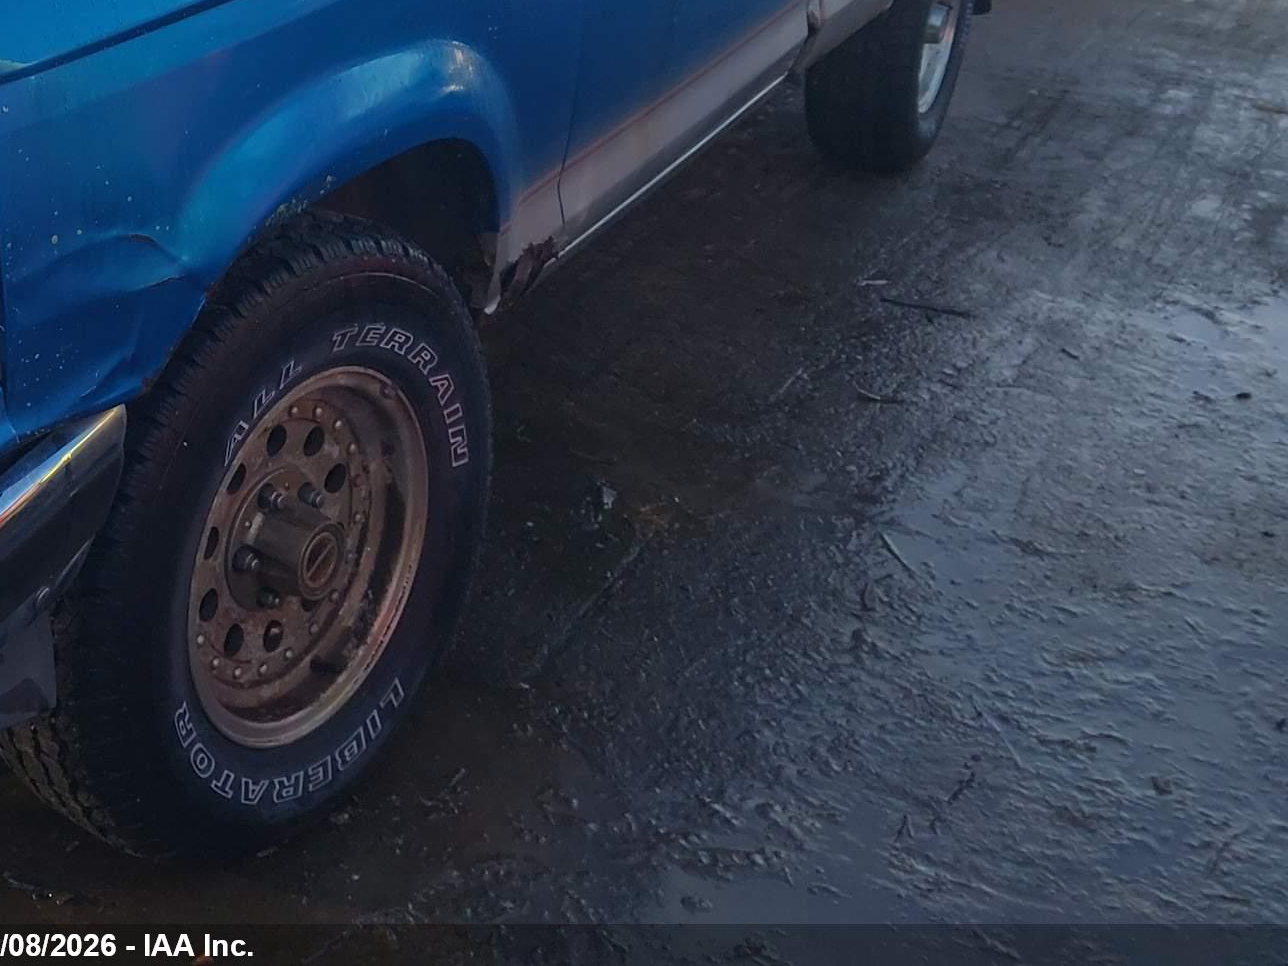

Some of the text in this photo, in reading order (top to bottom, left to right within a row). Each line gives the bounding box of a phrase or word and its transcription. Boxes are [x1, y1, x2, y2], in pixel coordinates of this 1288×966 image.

[223, 324, 469, 468] ALL TERRAIN
[173, 678, 406, 806] LIBERATOR
